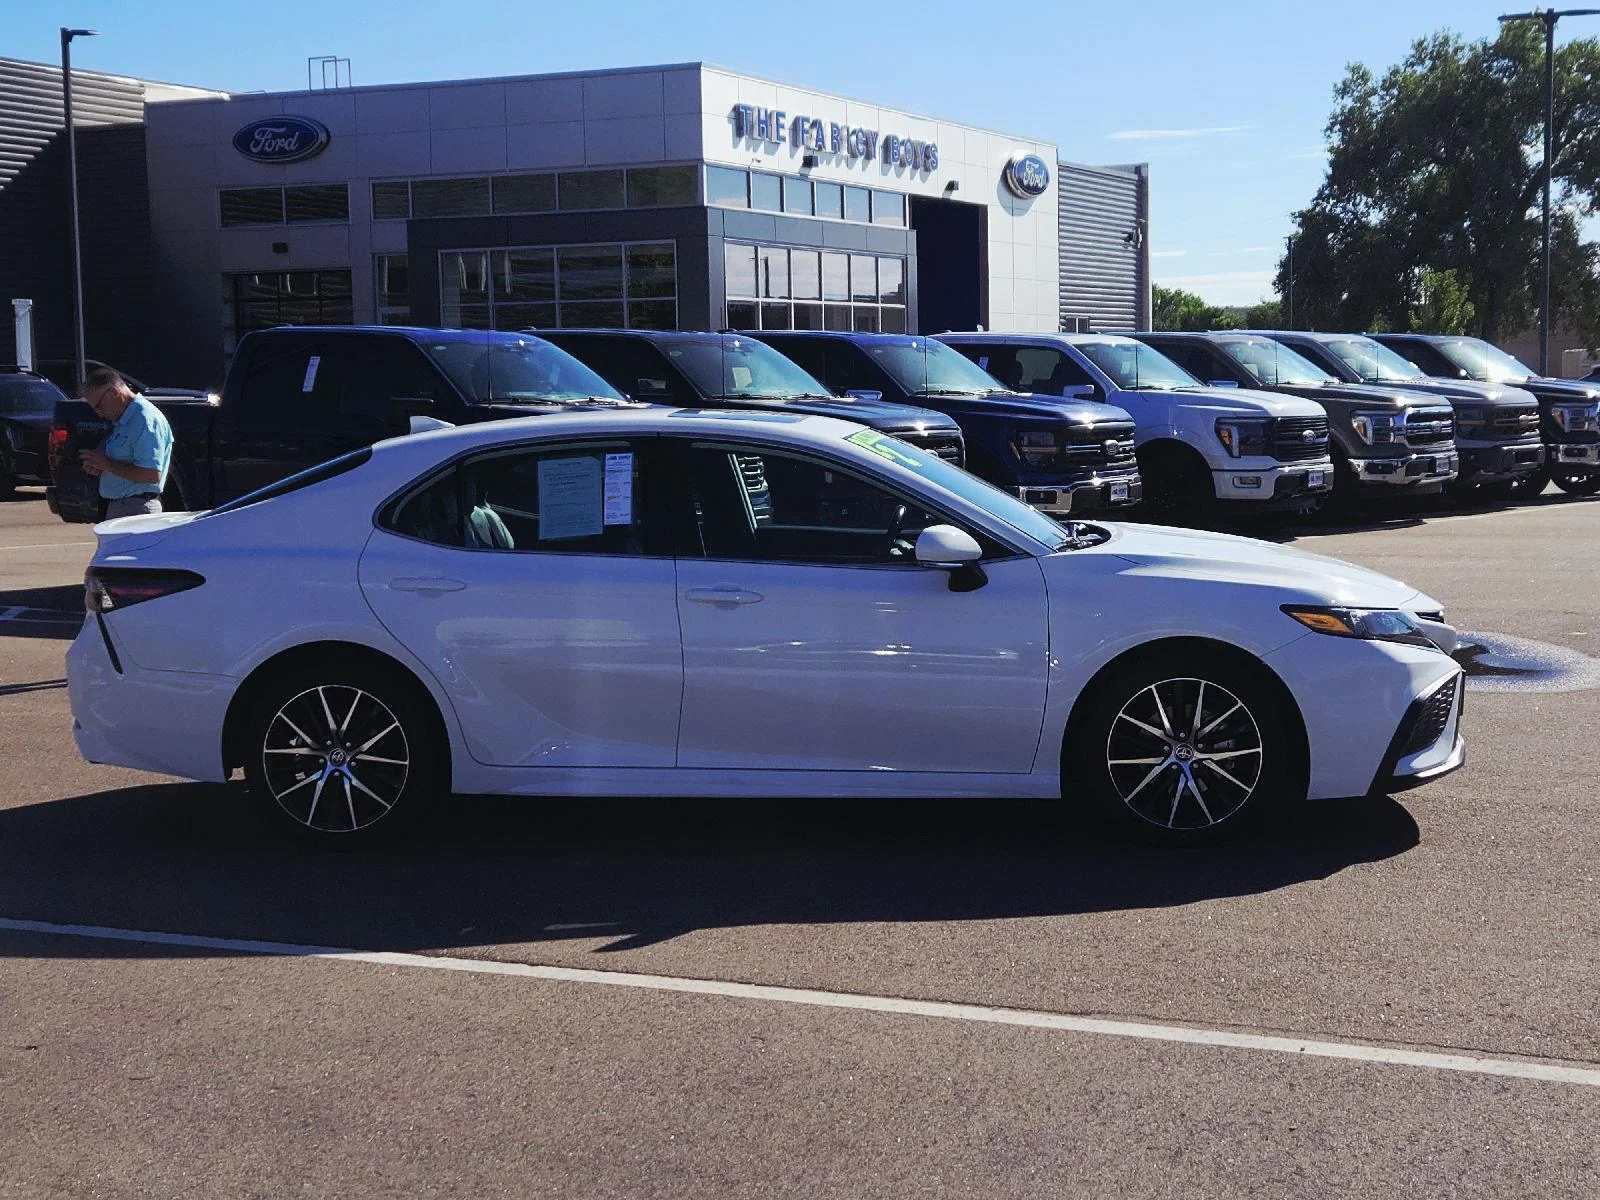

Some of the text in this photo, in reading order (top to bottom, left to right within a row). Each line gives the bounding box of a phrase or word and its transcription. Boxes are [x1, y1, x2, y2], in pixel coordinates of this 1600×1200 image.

[250, 125, 299, 153] Ford
[736, 103, 939, 172] THE FARICY BOYS
[1022, 160, 1045, 188] Ford
